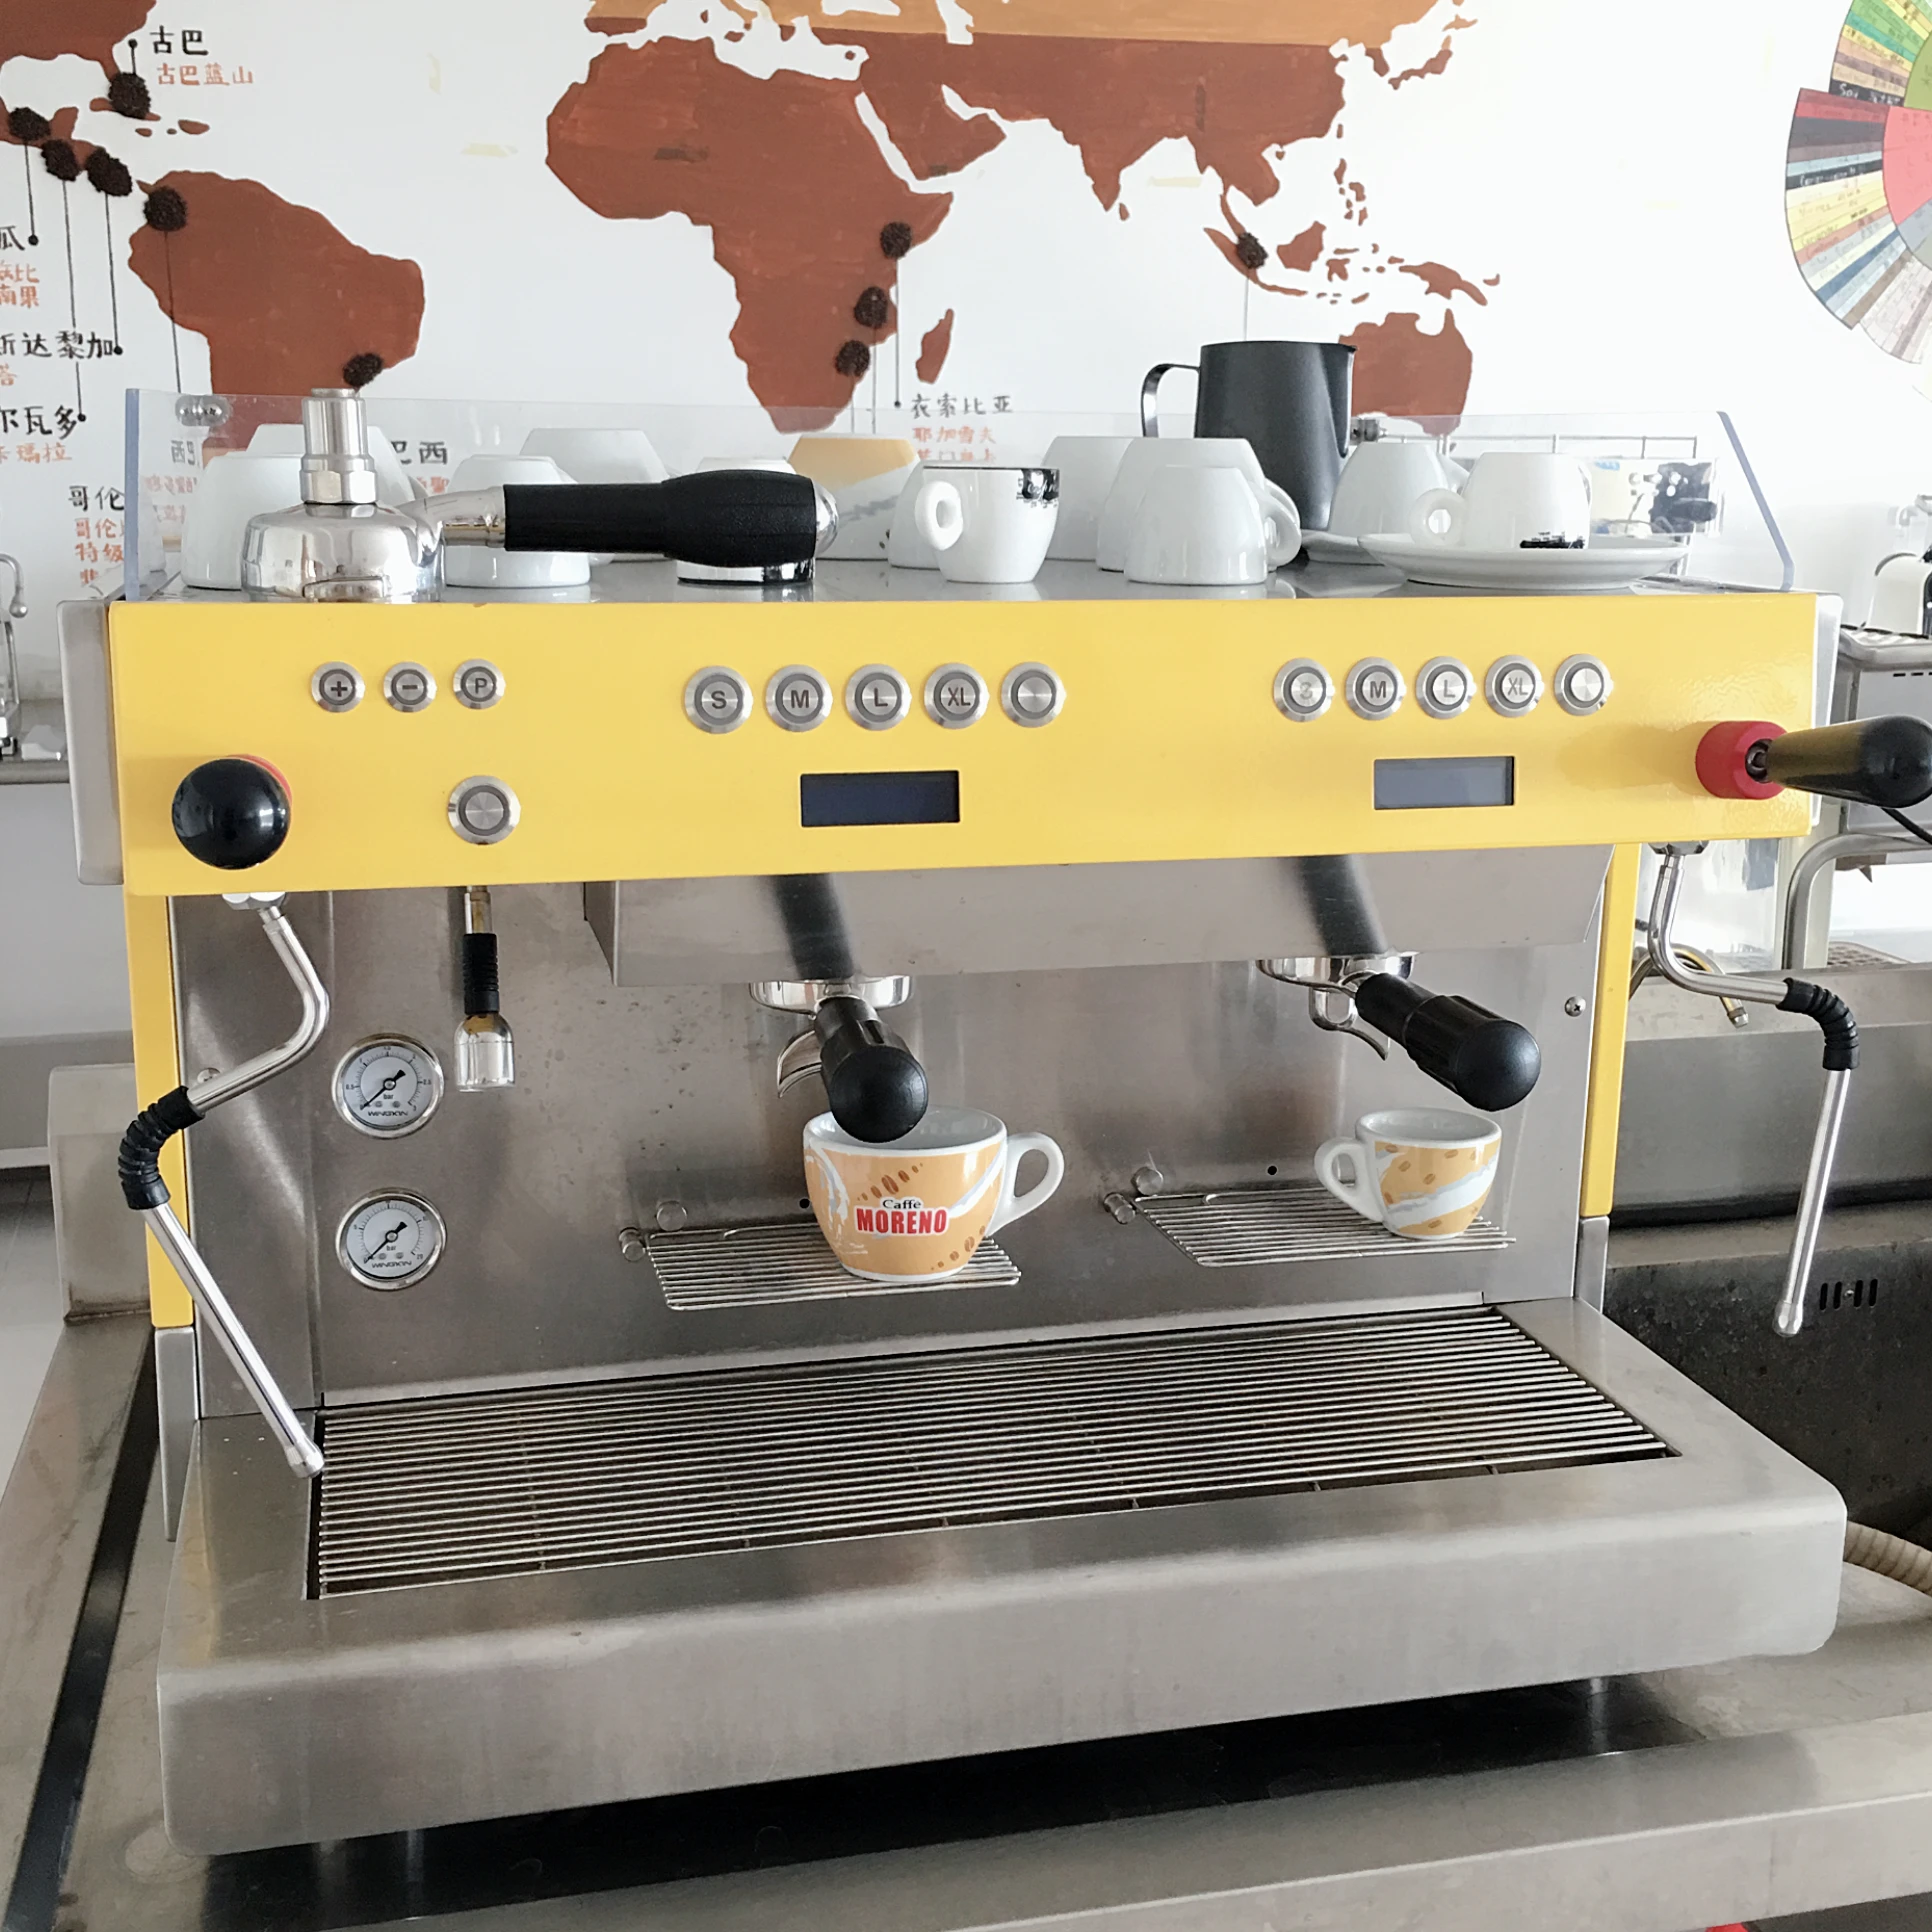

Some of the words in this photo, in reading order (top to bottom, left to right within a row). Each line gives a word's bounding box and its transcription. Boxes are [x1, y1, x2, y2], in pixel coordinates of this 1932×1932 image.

[150, 25, 209, 56] 古巴
[157, 62, 254, 86] 古巴蓝山
[911, 393, 1014, 419] 衣索比亚
[75, 517, 125, 540] 哥伦
[474, 677, 487, 694] P
[1369, 680, 1388, 699] M
[1443, 679, 1457, 698] L
[1506, 677, 1529, 697] XL
[711, 690, 727, 709] S
[791, 689, 810, 709] M
[874, 687, 889, 708] L
[947, 686, 972, 707] XL
[856, 1208, 948, 1234] MORENO
